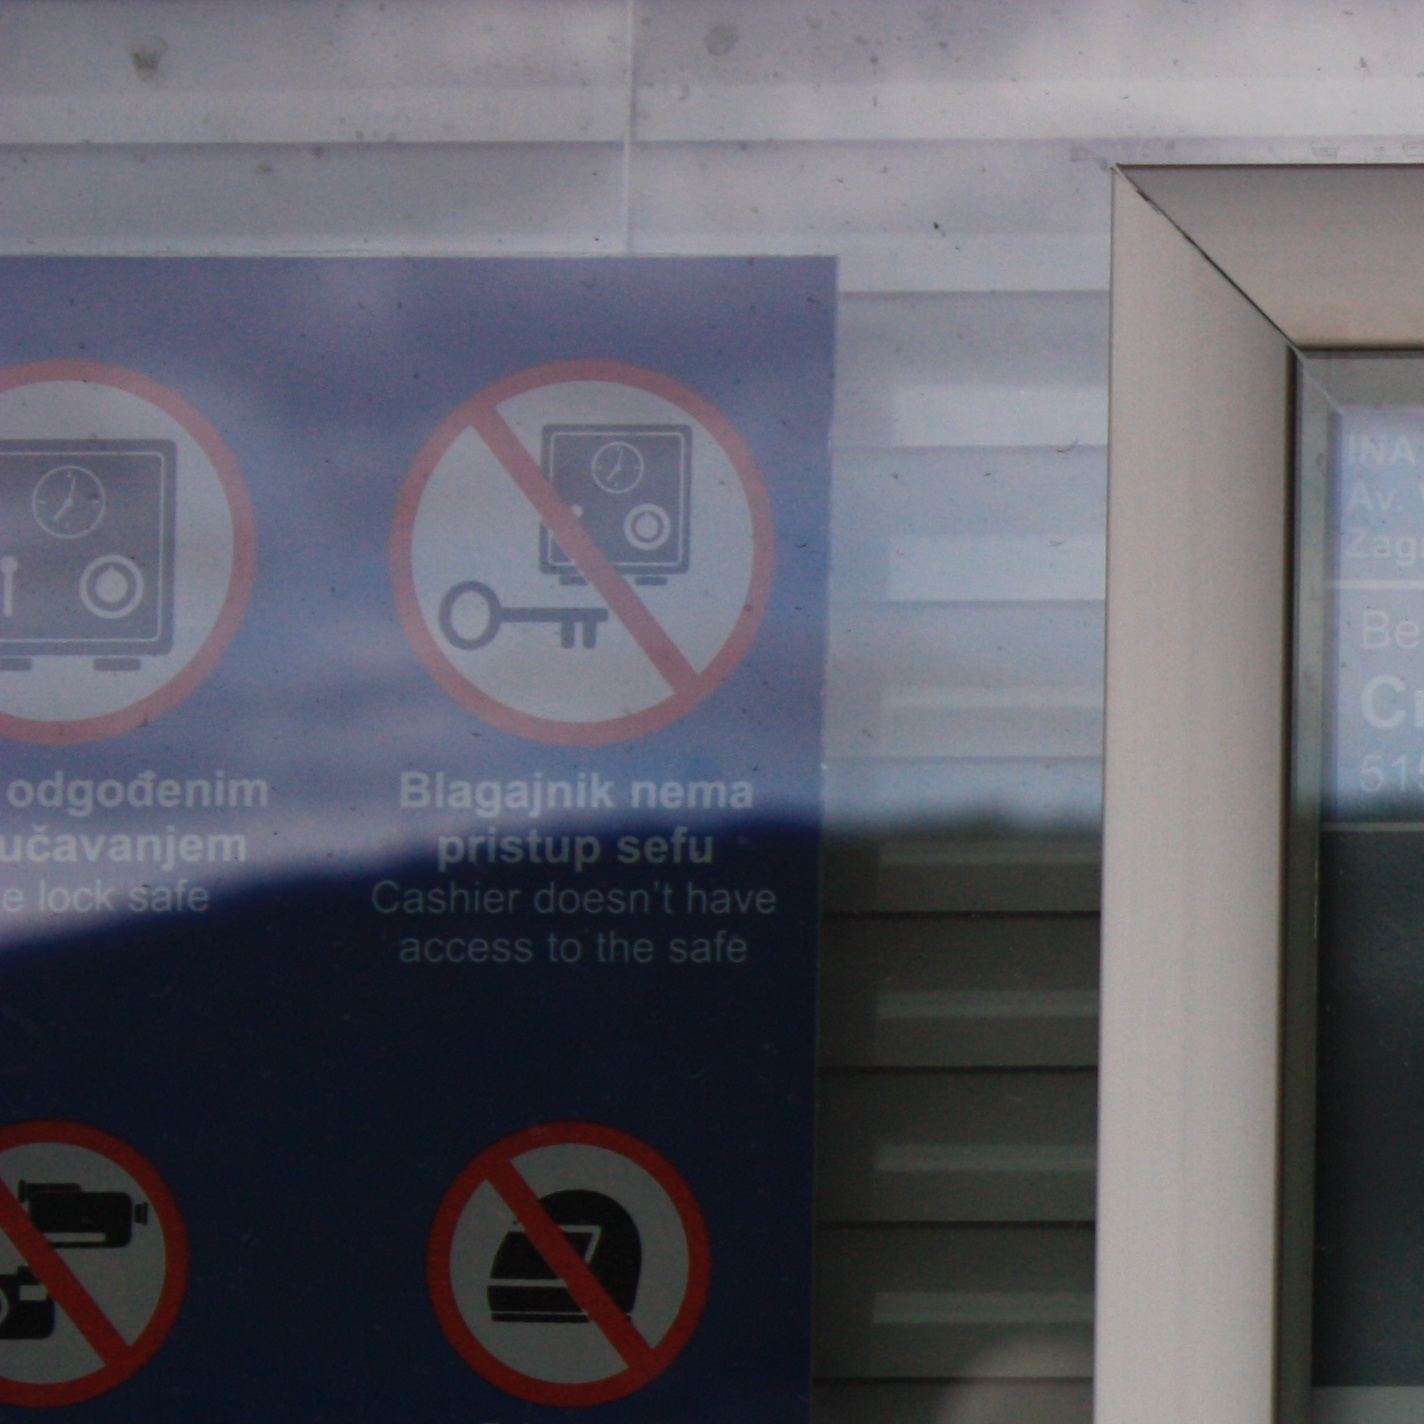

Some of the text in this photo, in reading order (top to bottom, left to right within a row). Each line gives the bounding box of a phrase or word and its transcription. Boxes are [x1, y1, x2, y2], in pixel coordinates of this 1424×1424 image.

[1346, 434, 1417, 465] INA
[7, 770, 268, 817] odgođenim
[402, 771, 754, 818] Blagajnik nema
[438, 826, 714, 872] pristup sefu
[39, 879, 116, 912] lock
[128, 878, 208, 912] safe
[372, 880, 518, 915] Cashier
[687, 880, 777, 914] have
[401, 930, 748, 965] access to the safe
